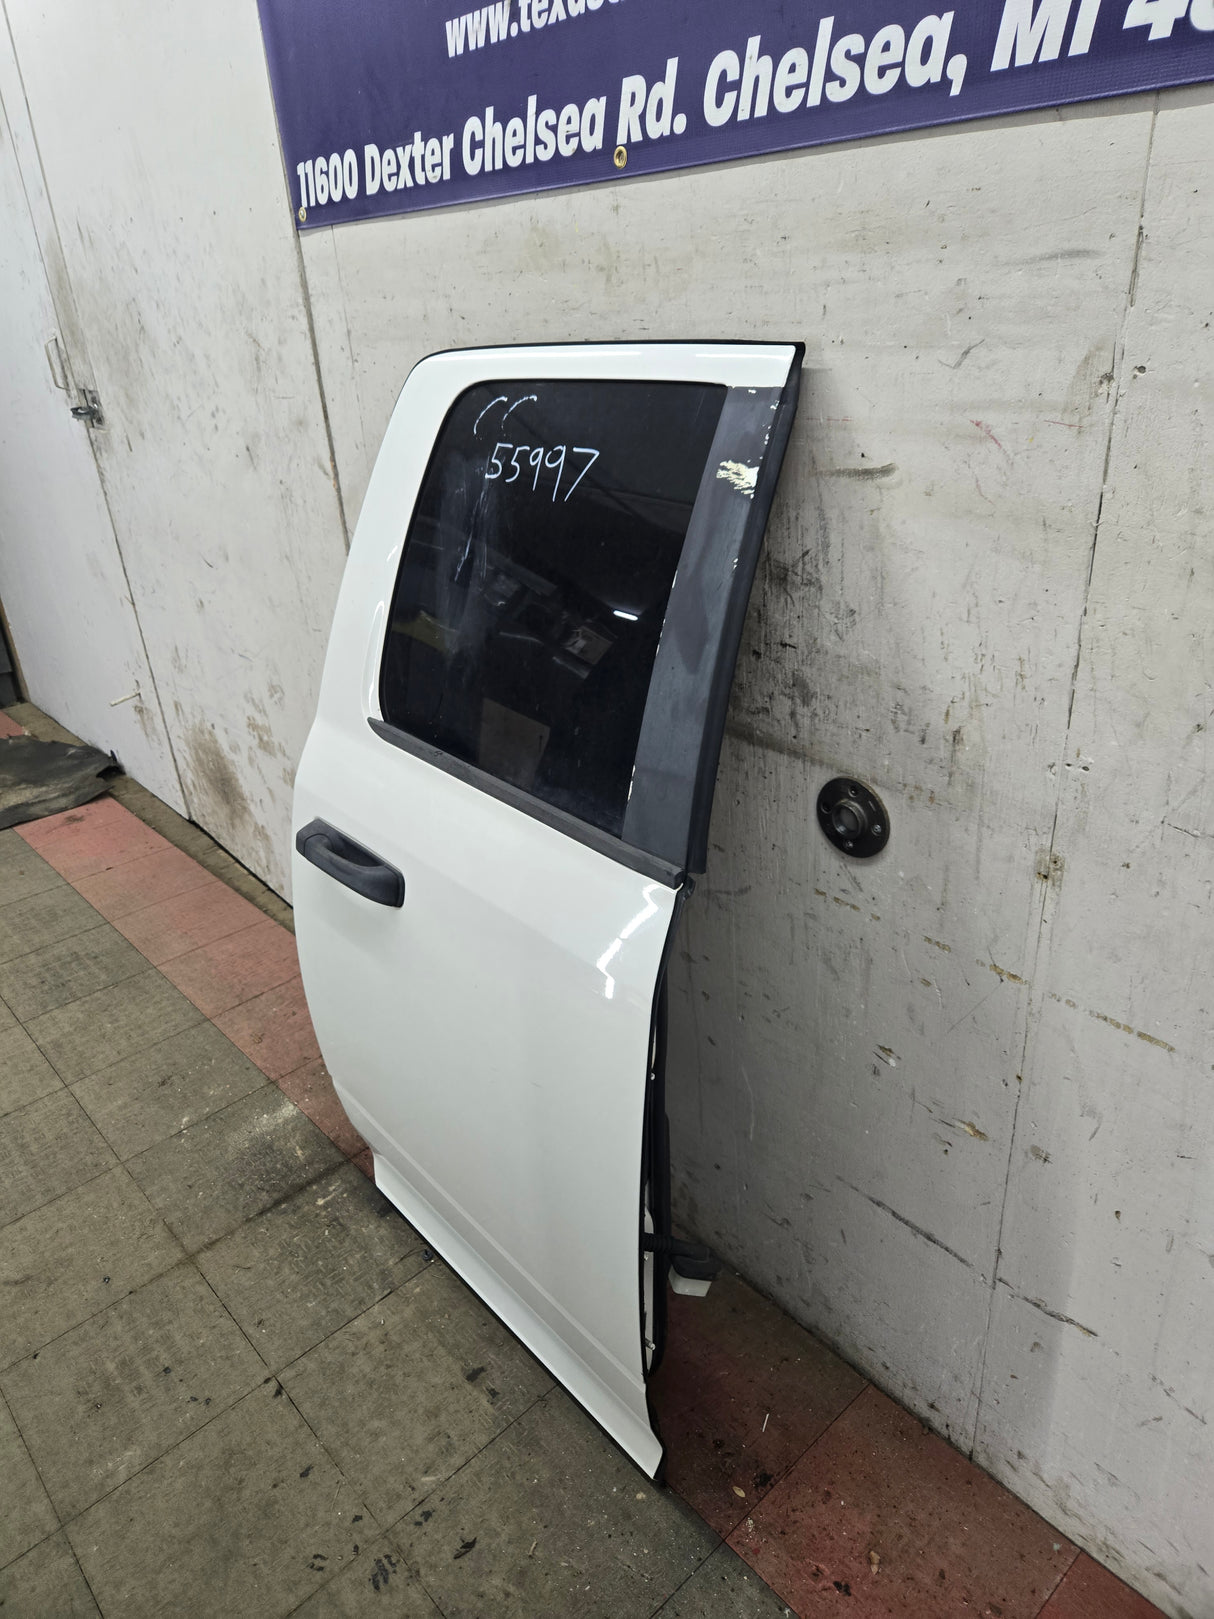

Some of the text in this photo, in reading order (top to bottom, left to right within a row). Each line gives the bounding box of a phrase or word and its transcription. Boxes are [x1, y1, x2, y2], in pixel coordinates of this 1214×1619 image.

[297, 149, 358, 207] 11600
[365, 131, 454, 195] Dexter
[462, 94, 606, 175] Chelsea
[616, 56, 687, 145] Rd.
[703, 10, 968, 127] Chelsea,
[484, 442, 600, 502] 55997
